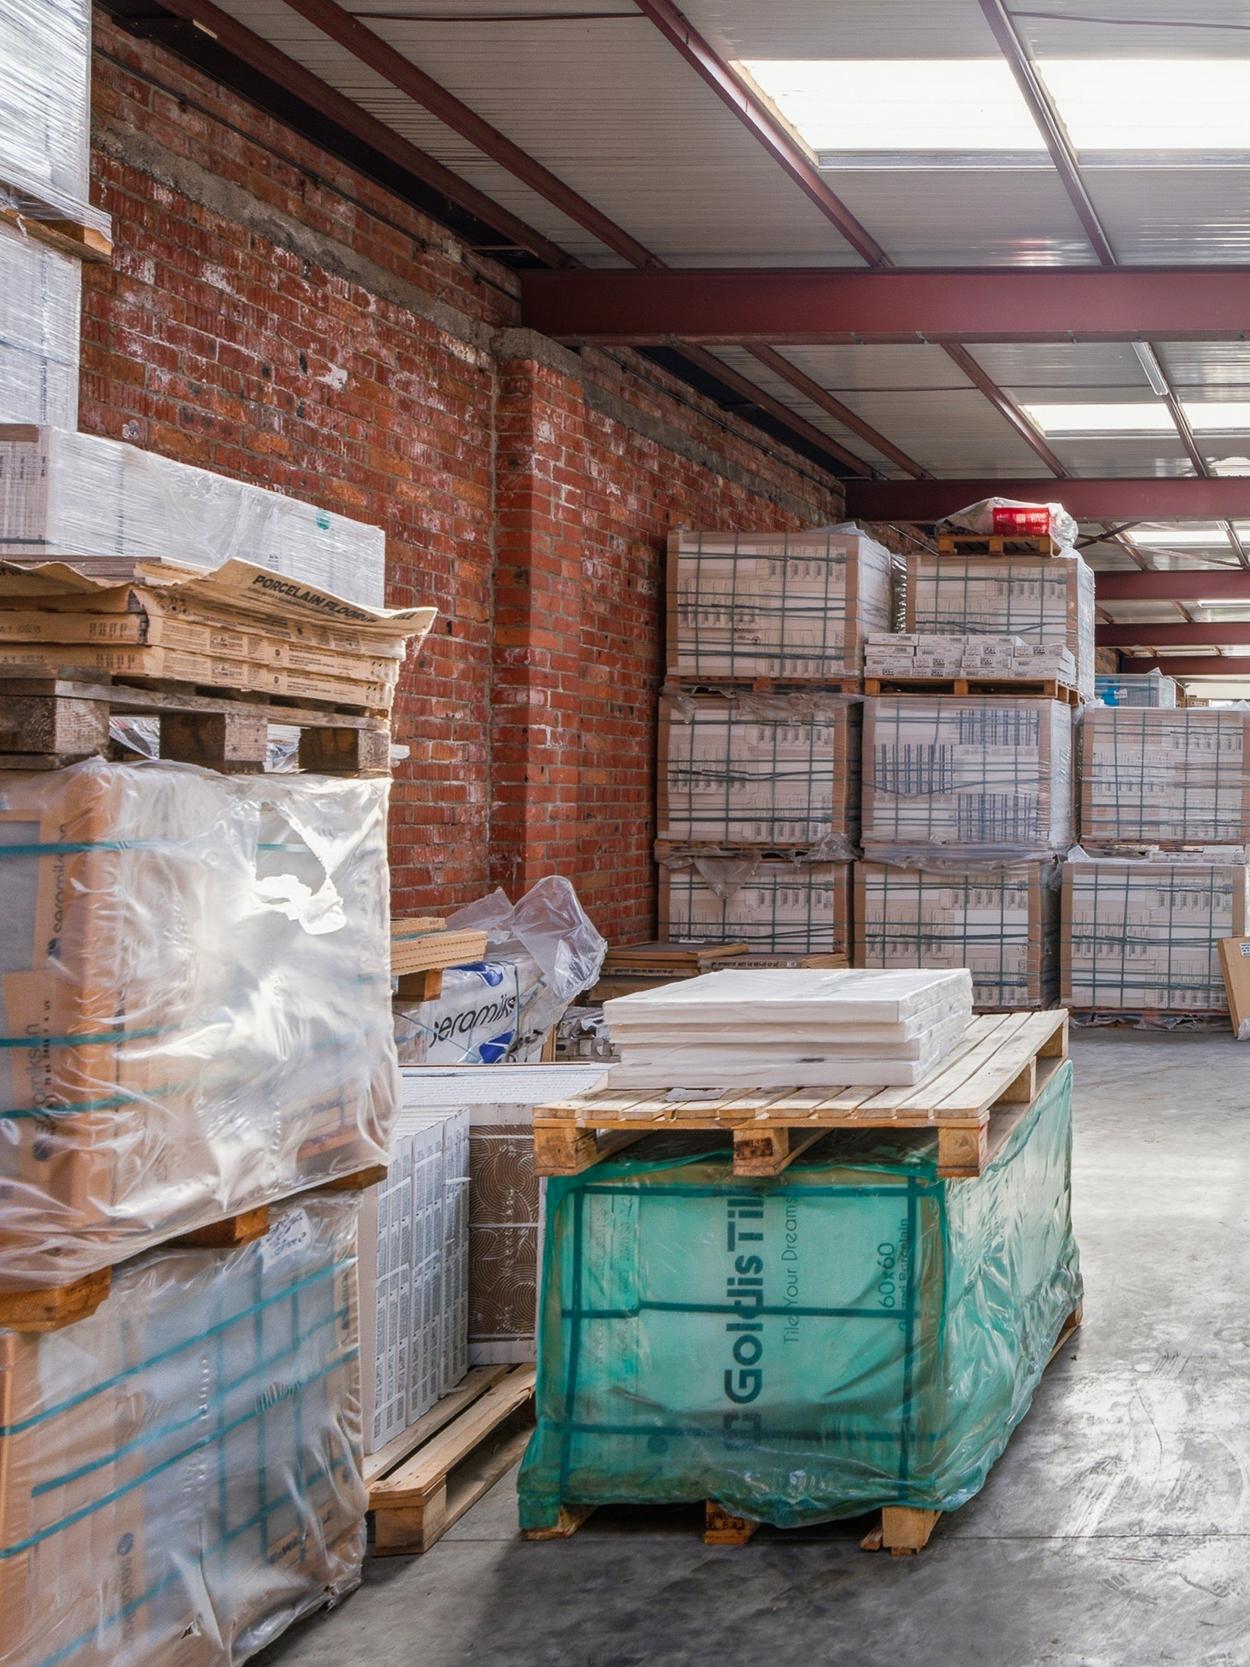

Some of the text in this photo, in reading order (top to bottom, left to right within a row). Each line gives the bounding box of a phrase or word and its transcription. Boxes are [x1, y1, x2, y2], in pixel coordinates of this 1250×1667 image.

[252, 575, 326, 607] PORCELAIN
[780, 1196, 799, 1345] Tile Your Dreams
[876, 1242, 896, 1309] 60x60
